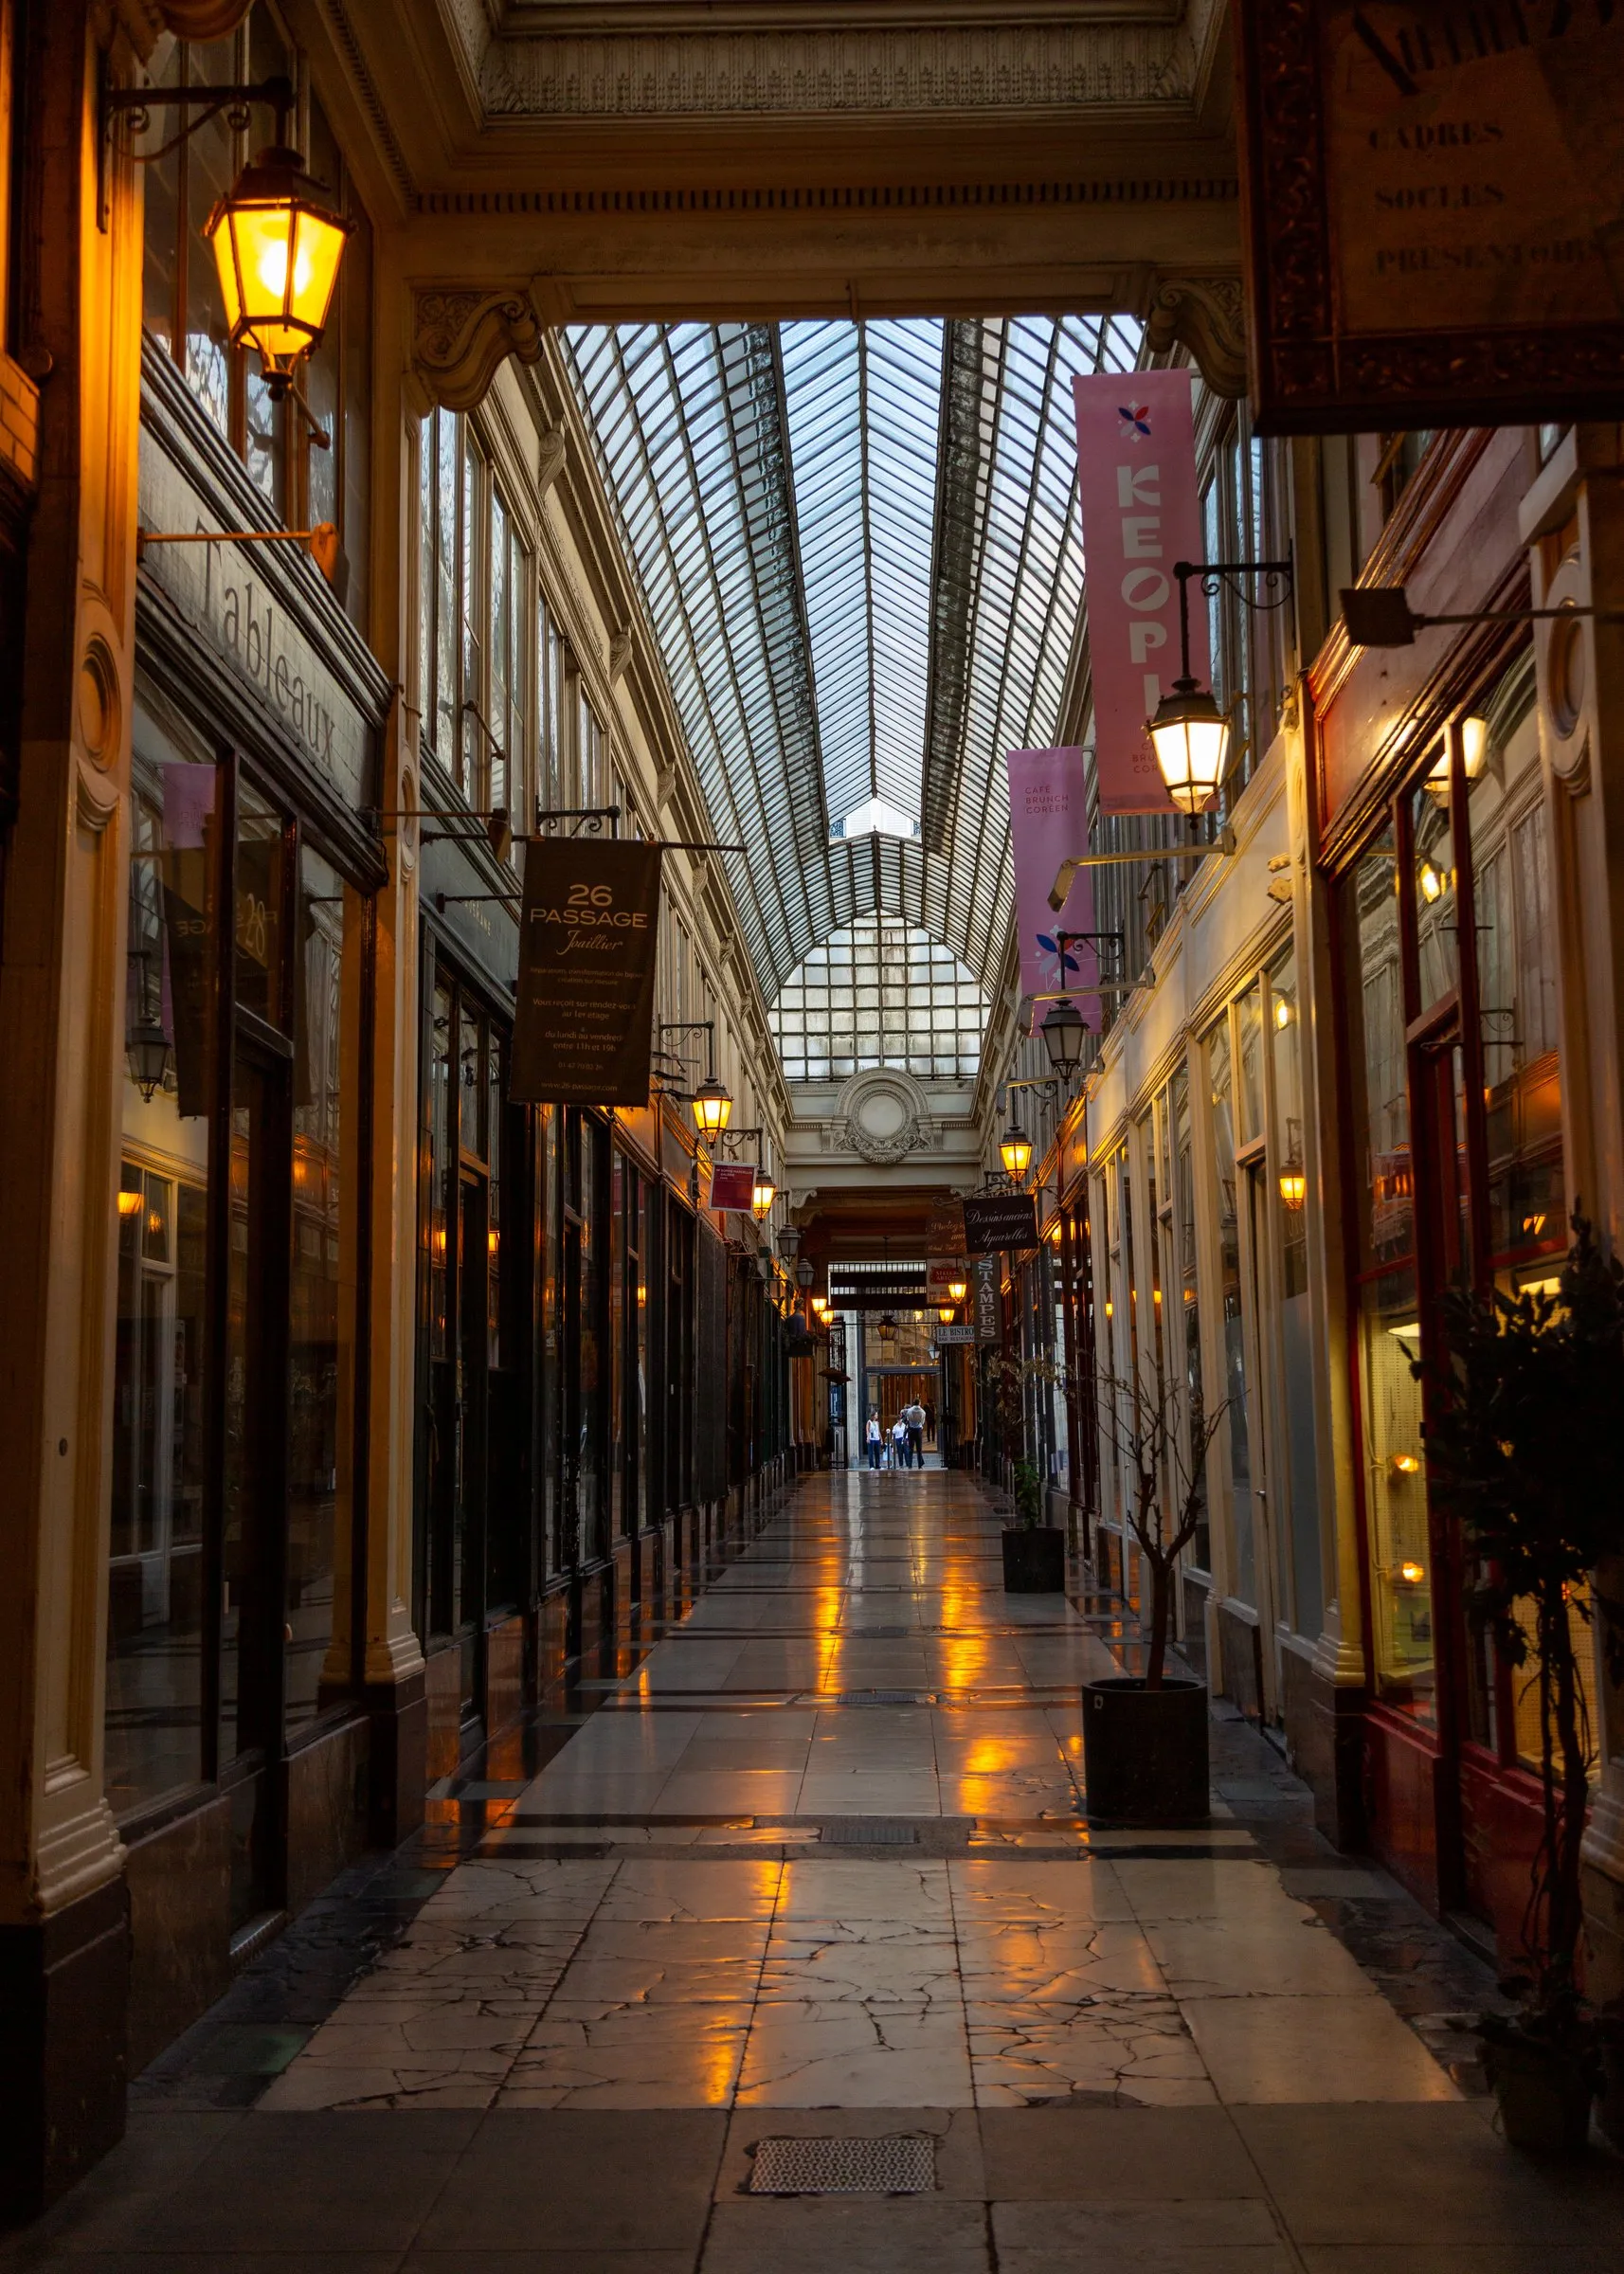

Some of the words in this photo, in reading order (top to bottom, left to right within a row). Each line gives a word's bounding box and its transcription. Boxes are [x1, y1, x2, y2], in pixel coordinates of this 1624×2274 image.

[1367, 120, 1505, 151] CADRES
[1374, 183, 1505, 210] SOCLES
[192, 514, 336, 768] Tableaux
[1026, 794, 1069, 804] BRUNCH
[567, 883, 613, 907] 26
[530, 908, 648, 929] PASSAGE
[557, 1030, 576, 1040] lundi
[578, 1032, 588, 1040] au
[965, 1208, 1002, 1225] Dessins
[1002, 1209, 1034, 1221] anciens
[974, 1226, 1029, 1249] Aquarelles
